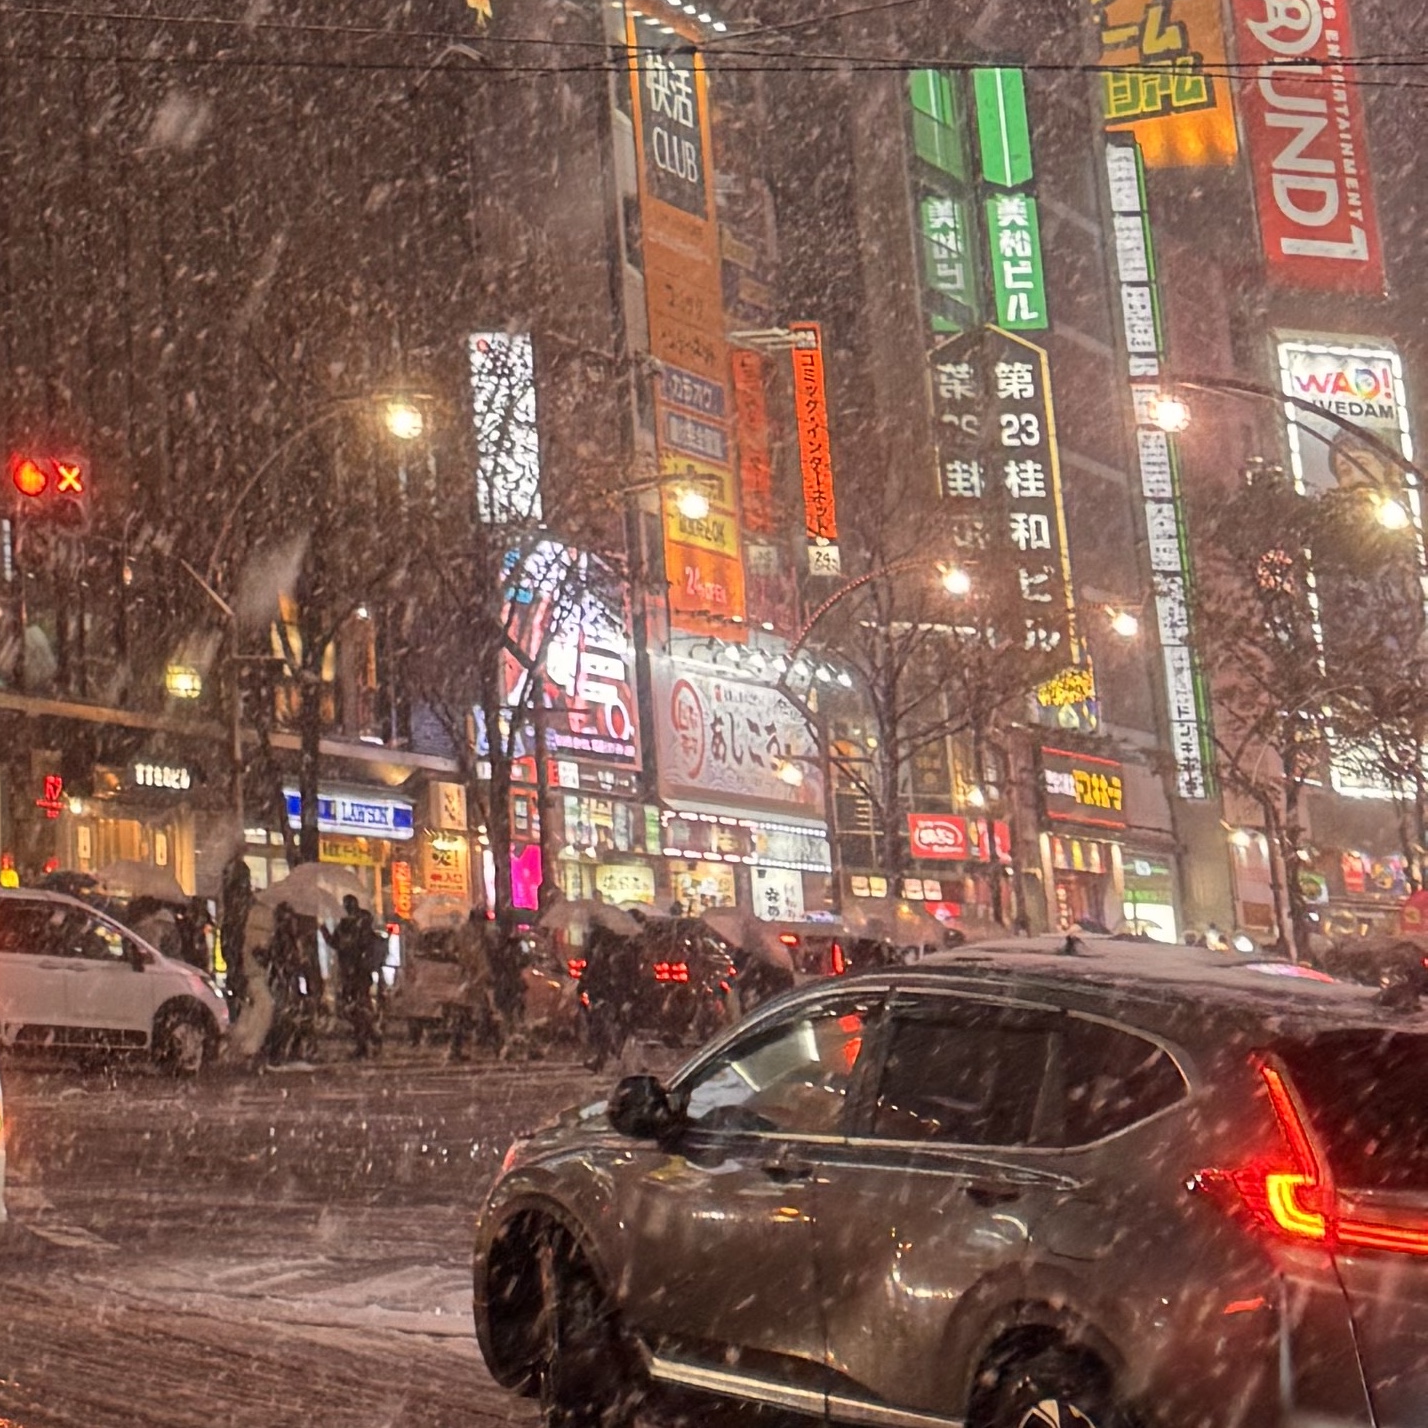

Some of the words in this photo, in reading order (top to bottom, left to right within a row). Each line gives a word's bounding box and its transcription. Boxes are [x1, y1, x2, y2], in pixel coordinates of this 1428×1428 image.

[645, 48, 694, 129] 快活
[652, 126, 698, 183] CLUB
[996, 194, 1039, 323] 美松ビル
[994, 360, 1061, 652] 第23桂和ビル
